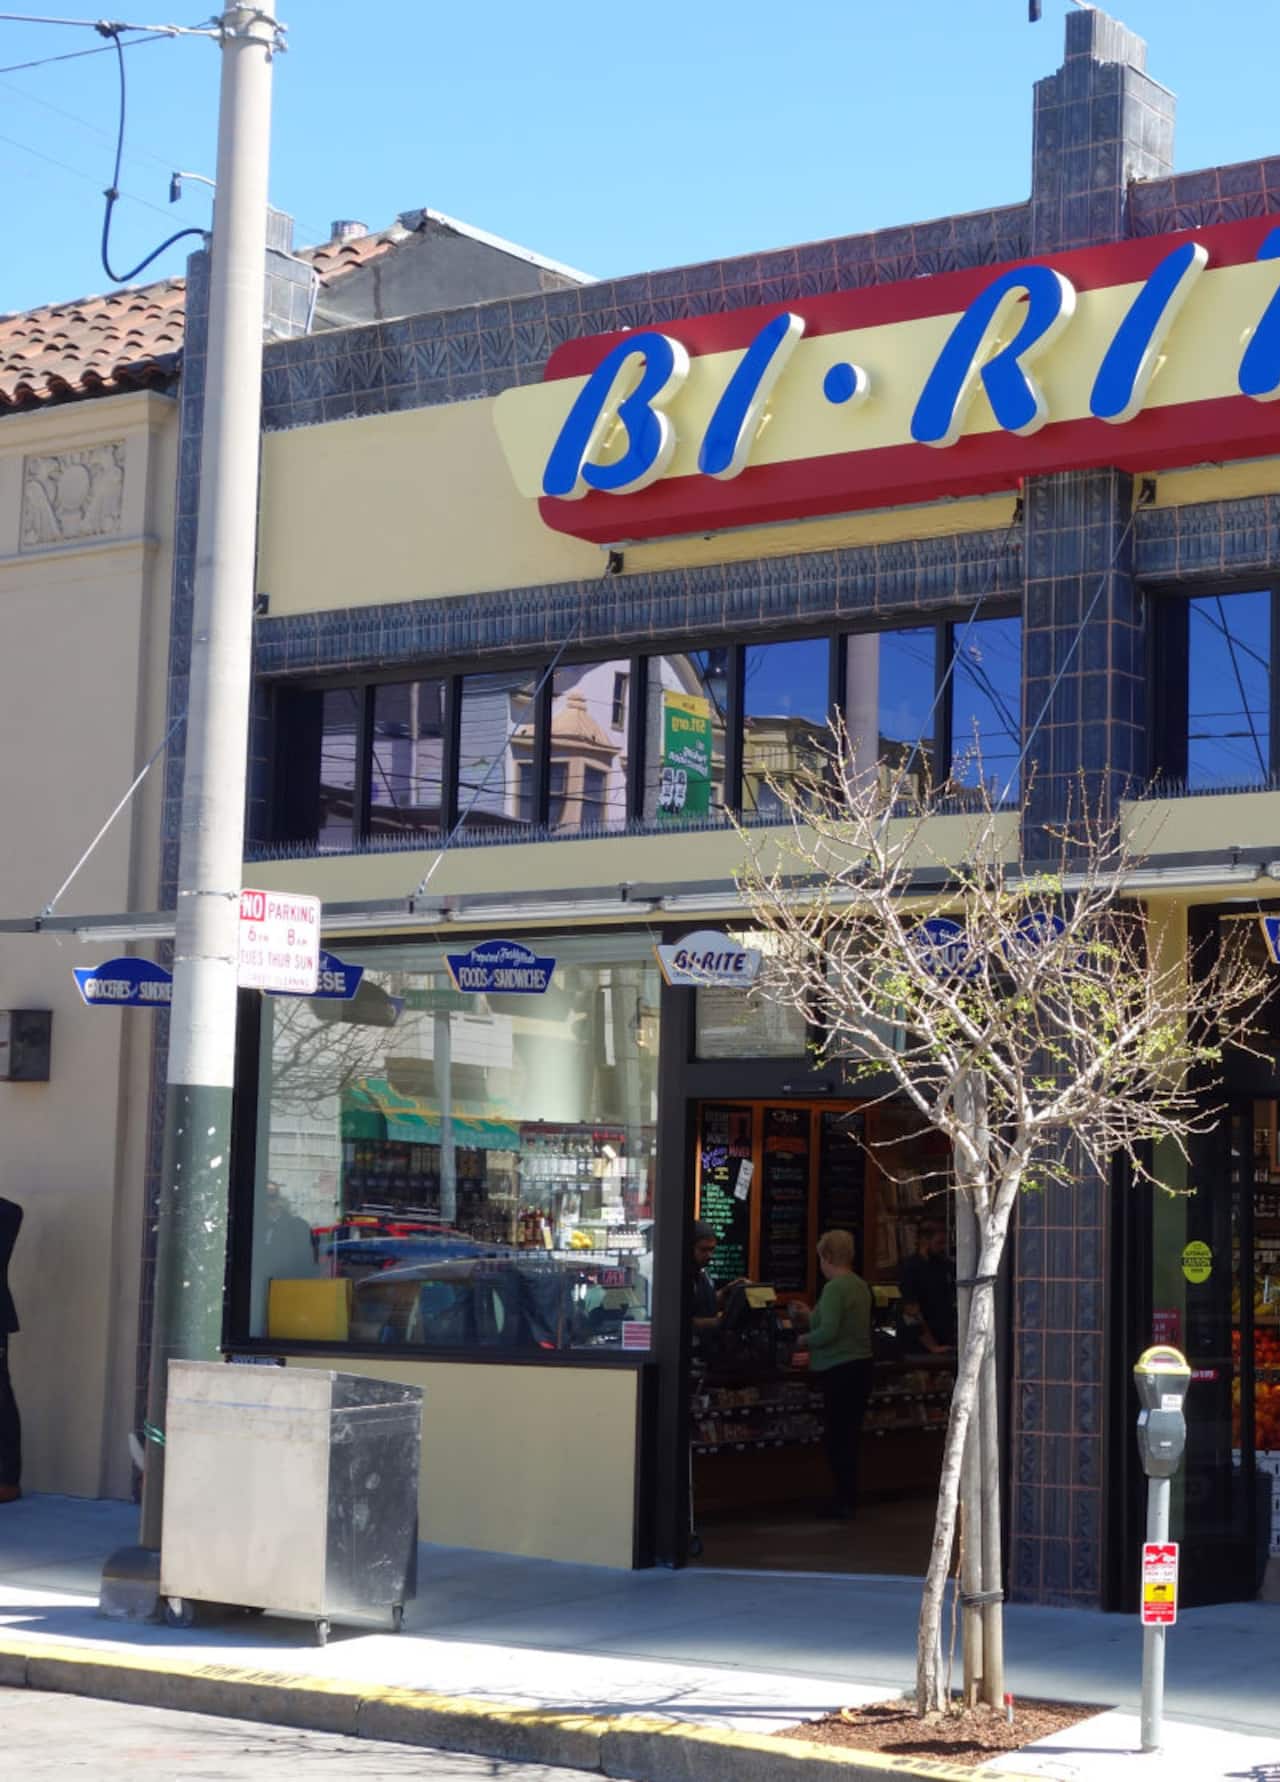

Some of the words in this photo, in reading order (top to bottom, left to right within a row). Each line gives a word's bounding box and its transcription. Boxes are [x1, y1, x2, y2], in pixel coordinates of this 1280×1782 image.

[241, 893, 264, 919] NO
[268, 901, 315, 924] PARKING
[295, 954, 313, 971] SUN
[458, 966, 488, 988] FOODS
[493, 968, 547, 989] SANDWICHES
